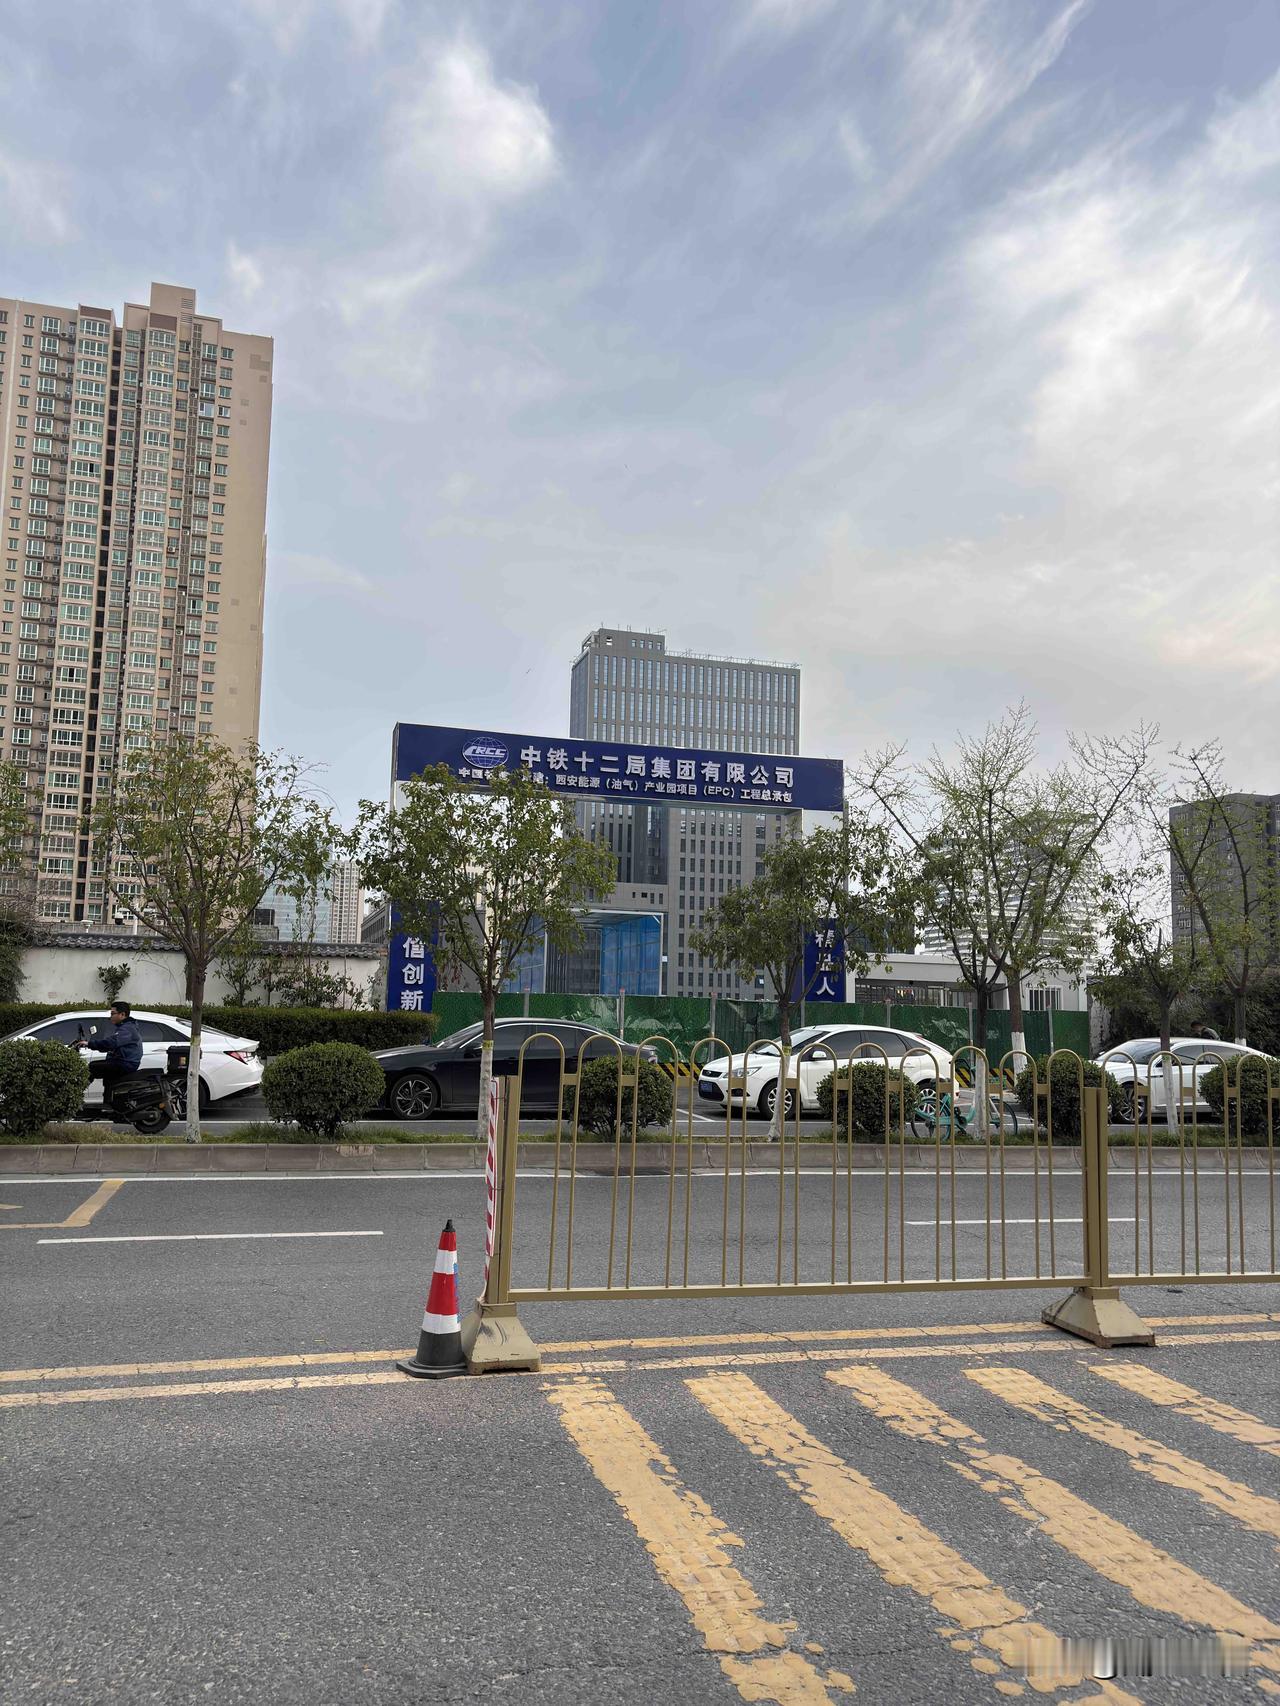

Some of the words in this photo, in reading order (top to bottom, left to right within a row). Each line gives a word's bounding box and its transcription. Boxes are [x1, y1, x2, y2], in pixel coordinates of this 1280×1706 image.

[521, 746, 794, 787] 中铁十二局集团有限公司
